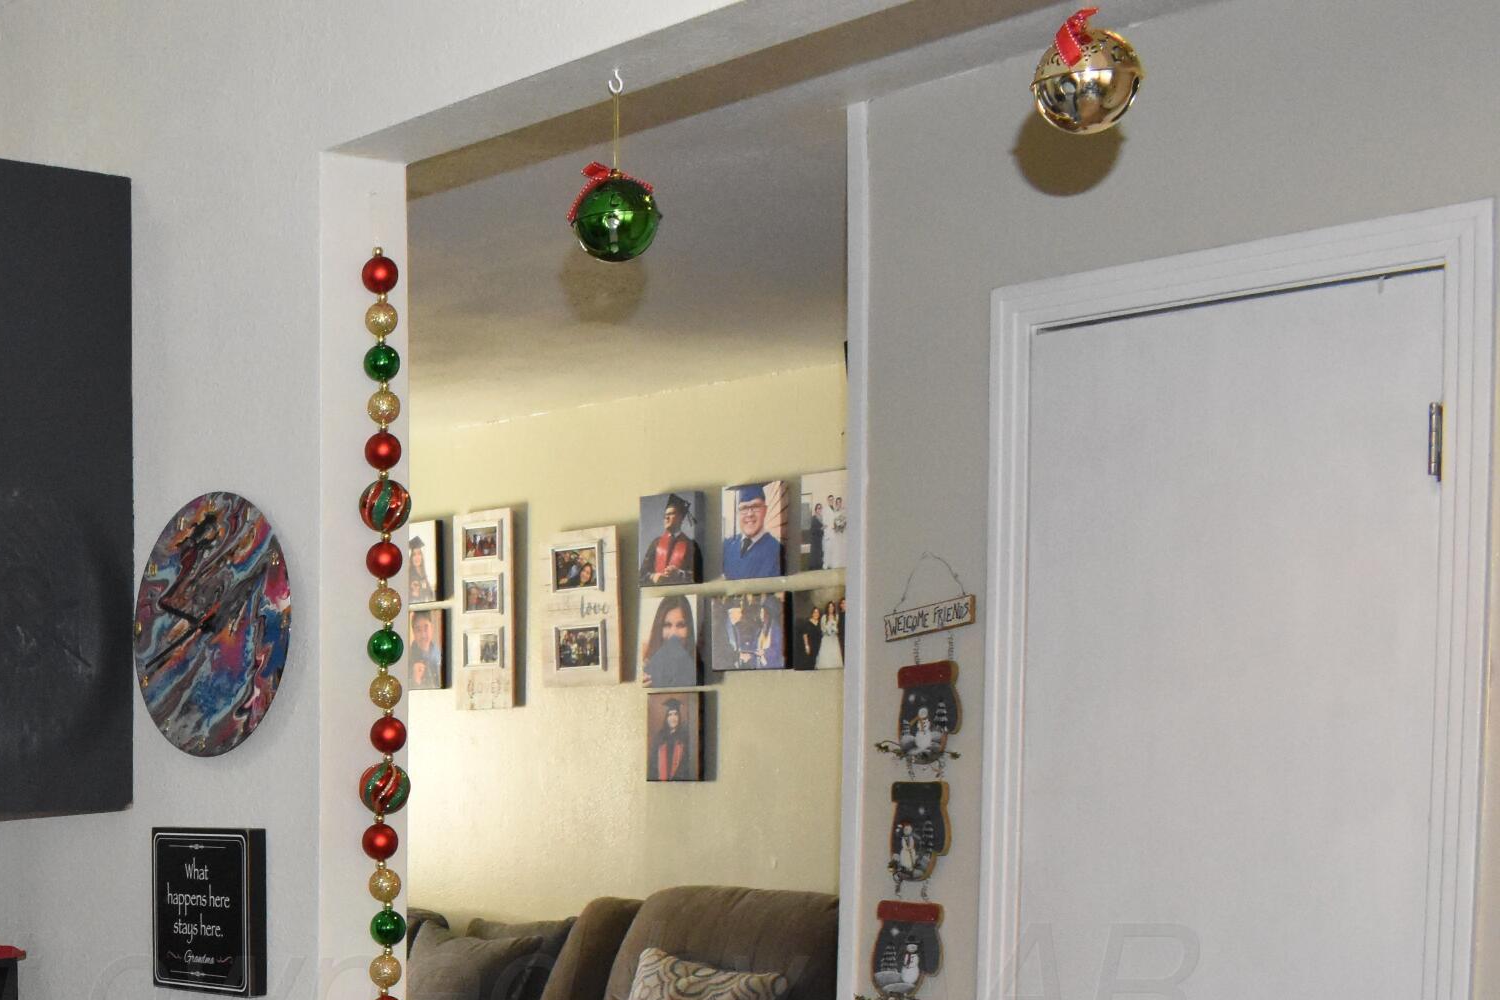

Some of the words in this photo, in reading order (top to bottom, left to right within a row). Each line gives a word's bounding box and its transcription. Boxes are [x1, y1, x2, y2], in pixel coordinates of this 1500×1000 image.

[580, 596, 609, 618] love
[888, 610, 930, 636] WELCOME
[933, 602, 969, 628] FRIENDS
[184, 856, 209, 881] What
[167, 882, 207, 916] happens
[208, 883, 230, 909] here
[173, 918, 198, 944] stays
[200, 912, 224, 938] here.
[183, 949, 215, 965] Grandma
